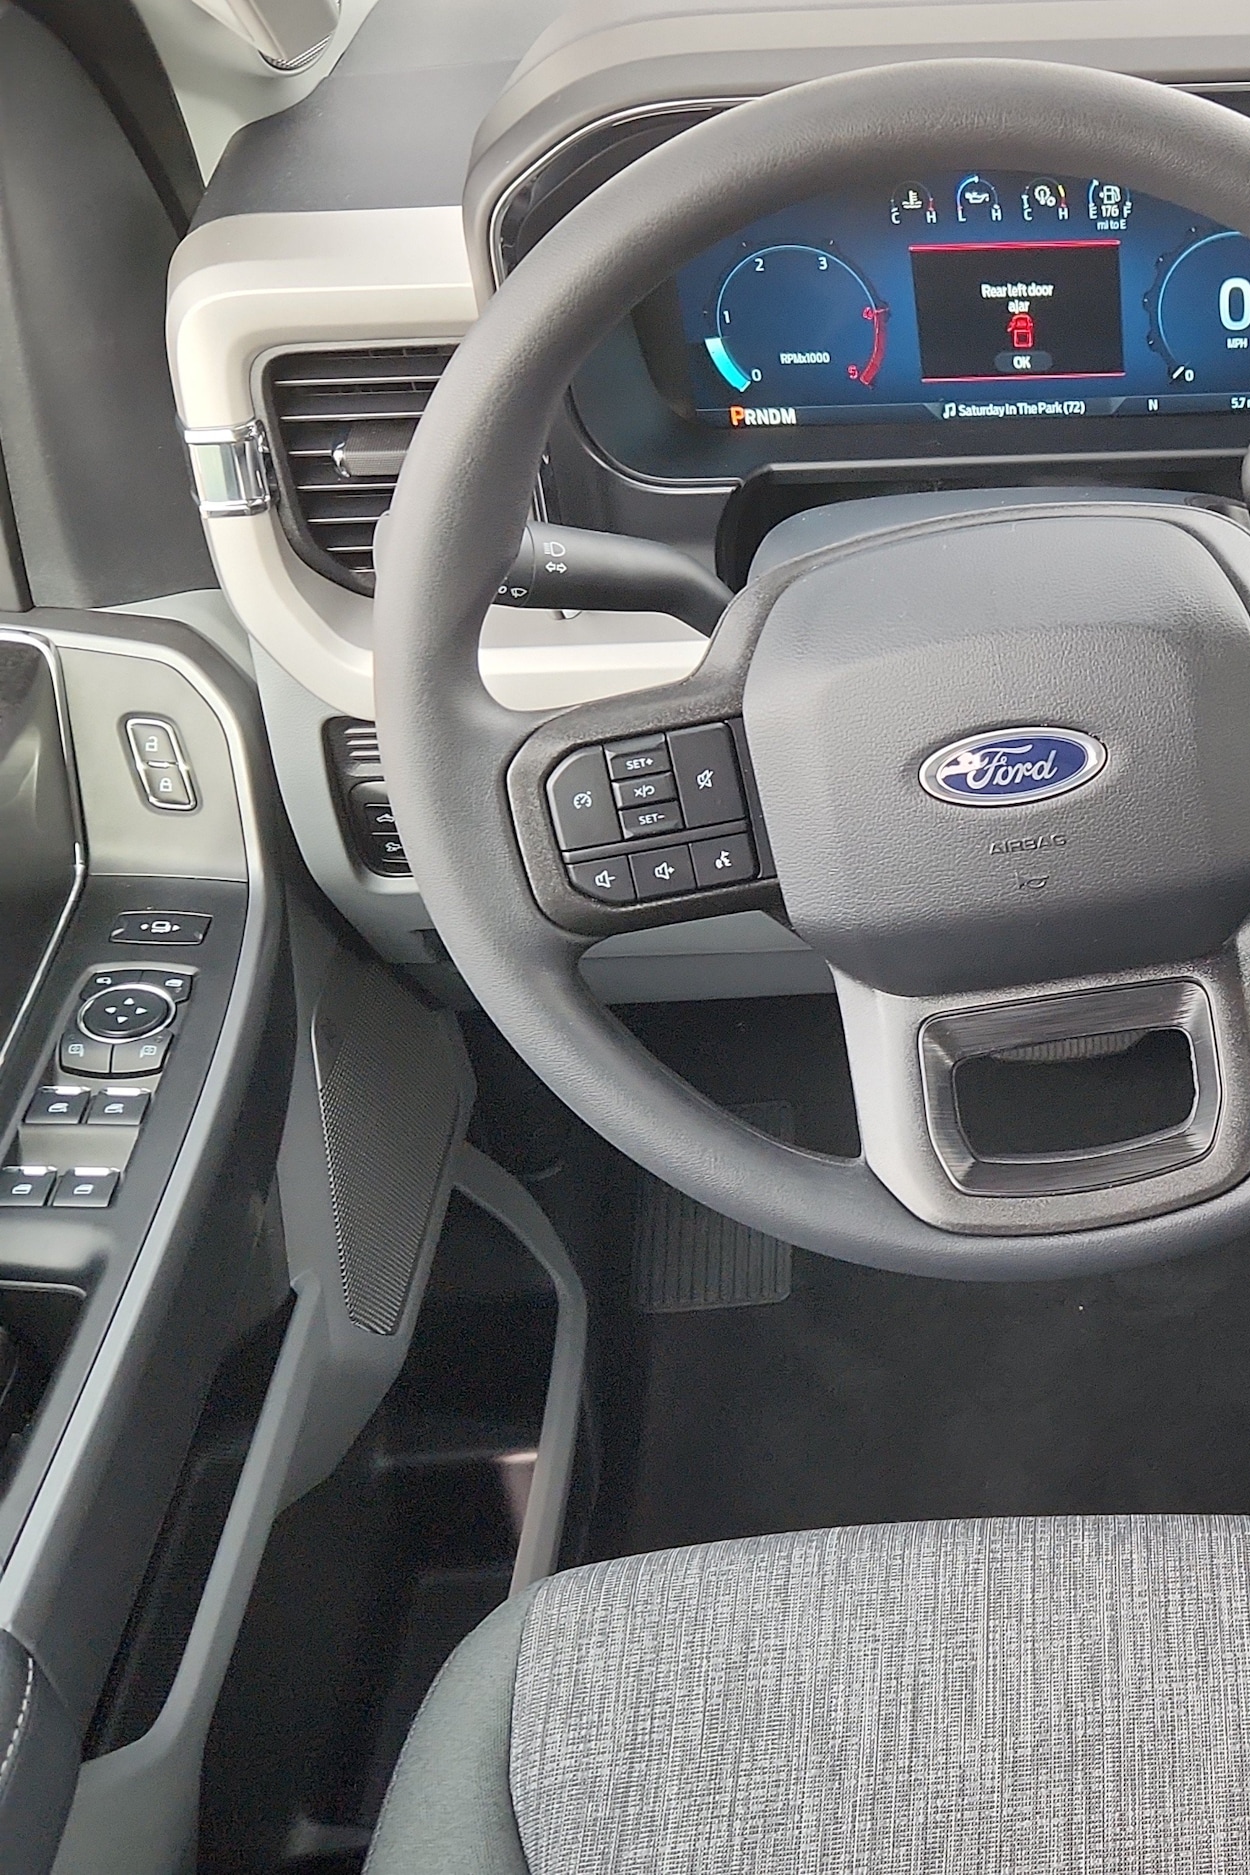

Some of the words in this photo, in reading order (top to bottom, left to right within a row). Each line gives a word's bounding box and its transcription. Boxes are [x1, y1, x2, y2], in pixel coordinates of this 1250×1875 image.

[891, 211, 901, 224] C
[926, 210, 937, 223] H
[957, 211, 967, 222] L
[992, 209, 1002, 221] H
[1023, 209, 1033, 221] C
[1058, 208, 1069, 220] H
[1089, 207, 1098, 219] E
[1101, 205, 1119, 217] 176
[1123, 206, 1132, 218] F
[1110, 220, 1119, 230] to
[1120, 219, 1127, 230] E
[754, 258, 765, 273] 2
[818, 257, 829, 271] 3
[981, 283, 1007, 298] Rear
[1007, 282, 1028, 297] left
[1028, 282, 1054, 297] door
[1008, 299, 1030, 314] ajar
[723, 310, 732, 324] 1
[1227, 338, 1248, 349] MPH
[780, 353, 831, 365] RPMx1000
[1012, 356, 1031, 369] OK
[751, 369, 762, 382] 0
[1184, 369, 1195, 382] 0
[958, 403, 1005, 418] Saturday
[1005, 403, 1017, 415] In
[1017, 402, 1037, 415] The
[1038, 401, 1062, 415] Park
[1063, 401, 1086, 415] (72)
[1148, 399, 1158, 411] N
[941, 744, 1058, 789] Ford
[989, 833, 1067, 856] AIRBAG
